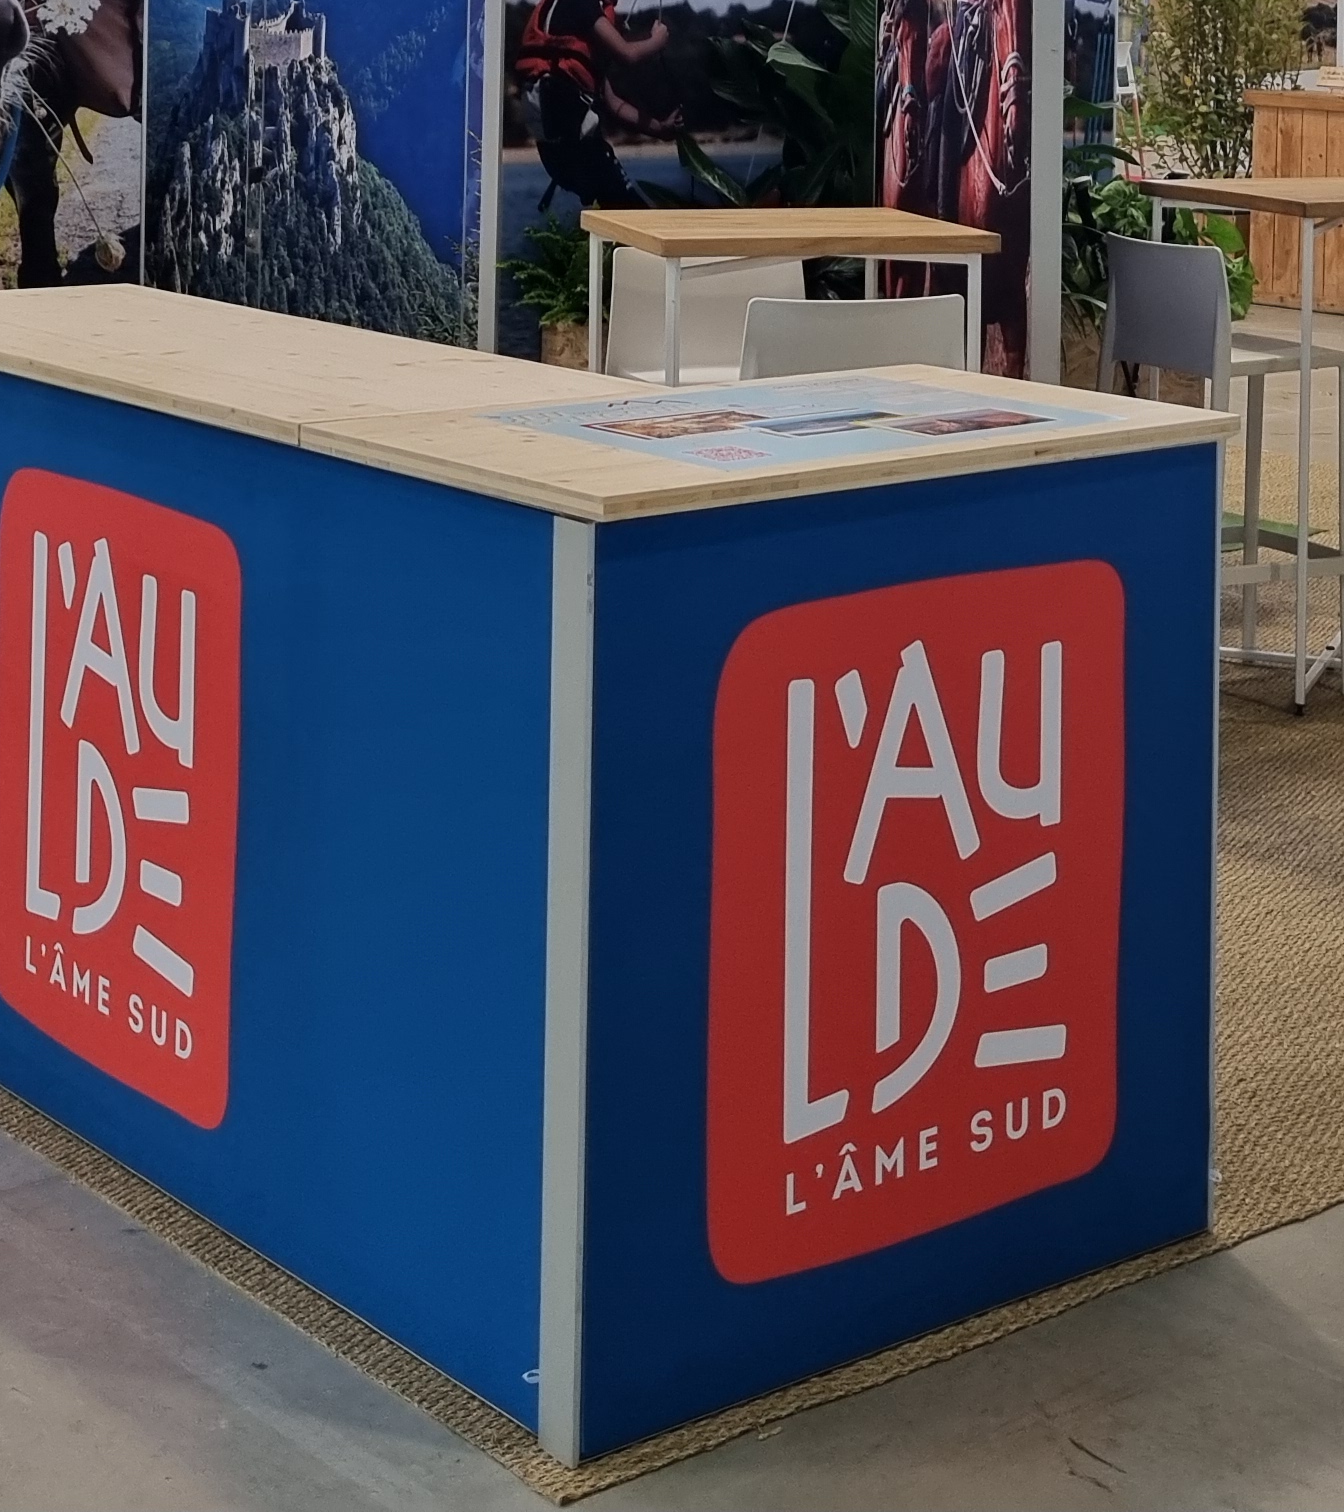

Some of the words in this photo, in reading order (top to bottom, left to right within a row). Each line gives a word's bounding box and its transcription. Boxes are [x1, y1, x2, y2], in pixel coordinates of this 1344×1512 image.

[25, 933, 111, 1018] L'ÂME
[128, 992, 194, 1061] SUD
[785, 1124, 940, 1216] L'ÂME
[969, 1087, 1068, 1154] SUD
